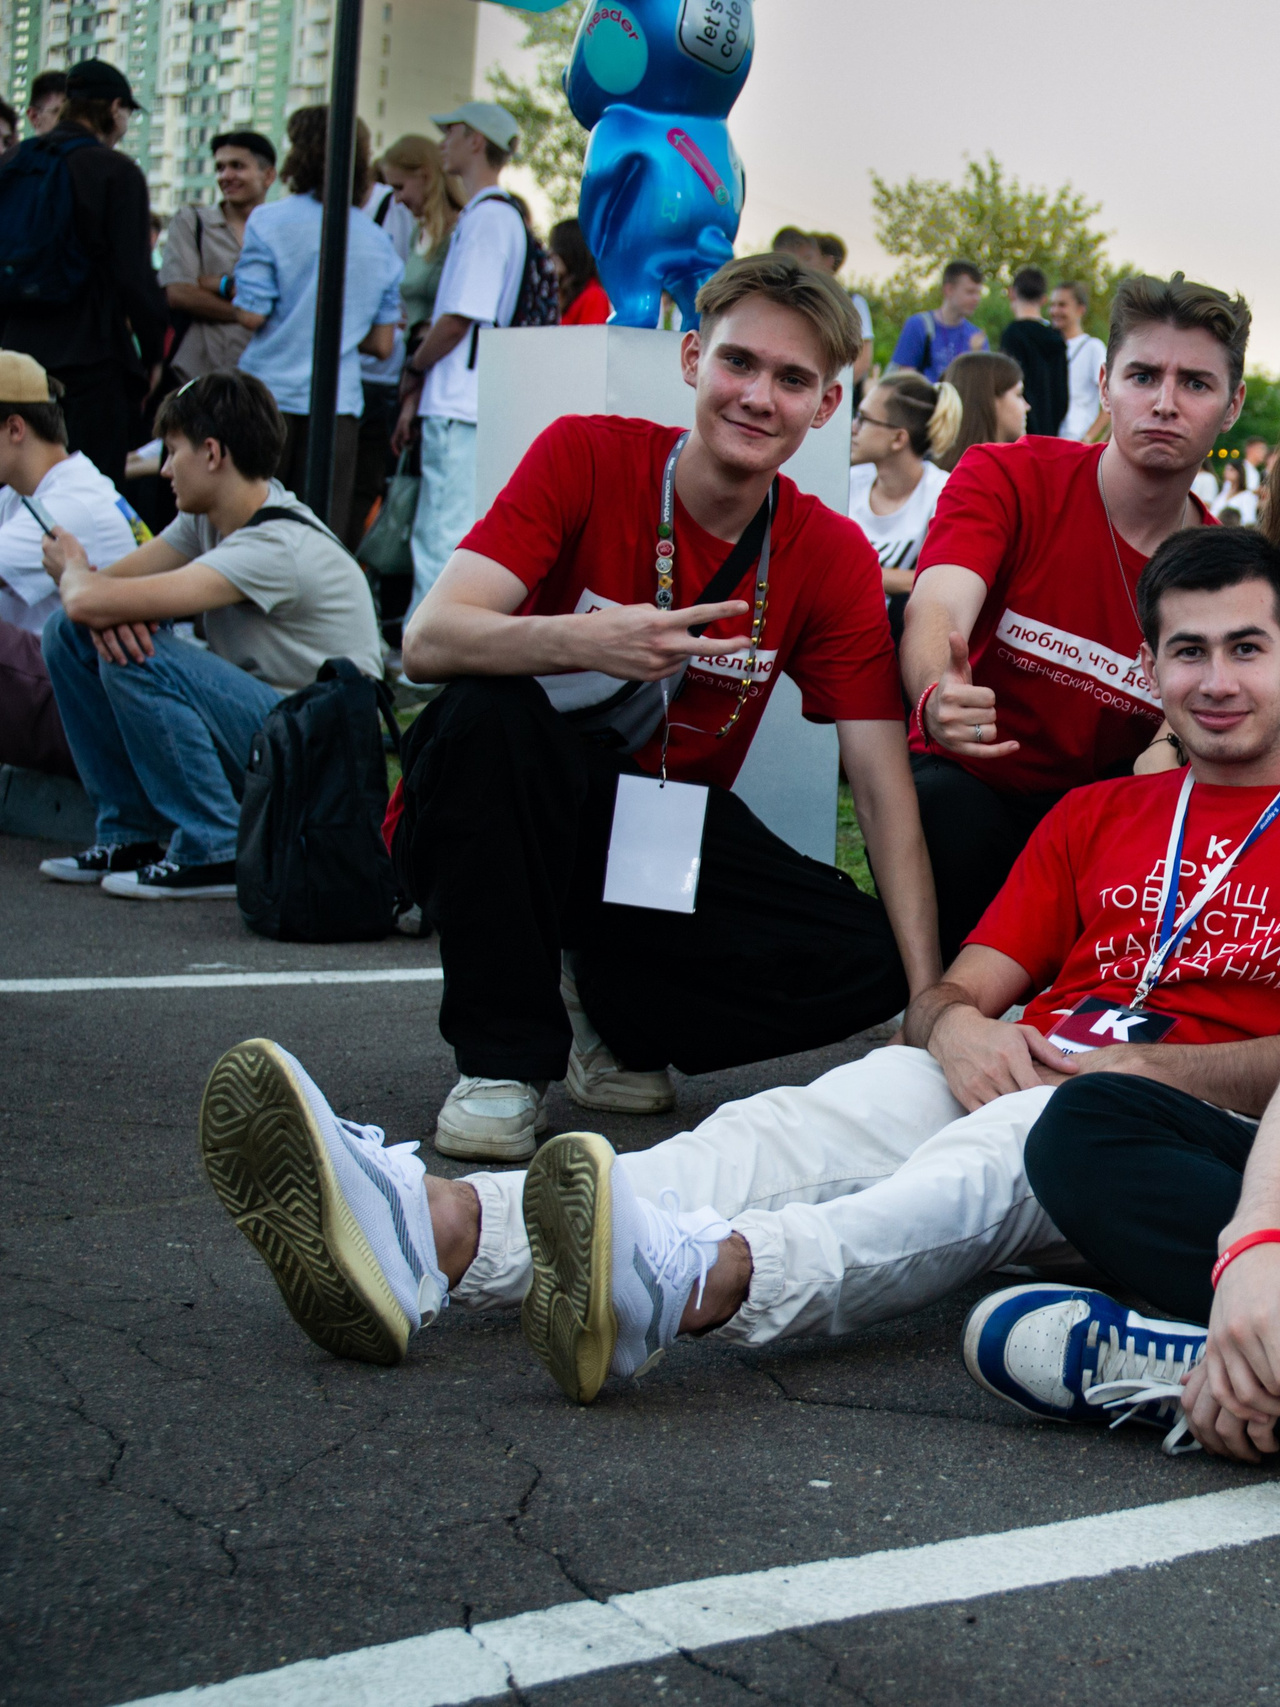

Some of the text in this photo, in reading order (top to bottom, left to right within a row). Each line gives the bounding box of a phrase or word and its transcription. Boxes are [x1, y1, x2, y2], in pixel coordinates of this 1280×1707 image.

[695, 0, 724, 47] let's
[1006, 624, 1152, 693] люблю, что де
[997, 647, 1165, 725] СТУДЕНЧЕСКИЙ СОЮЗ МИРЭ
[1145, 859, 1238, 886] ДРУ
[1099, 881, 1269, 914] ТОВАИЩ
